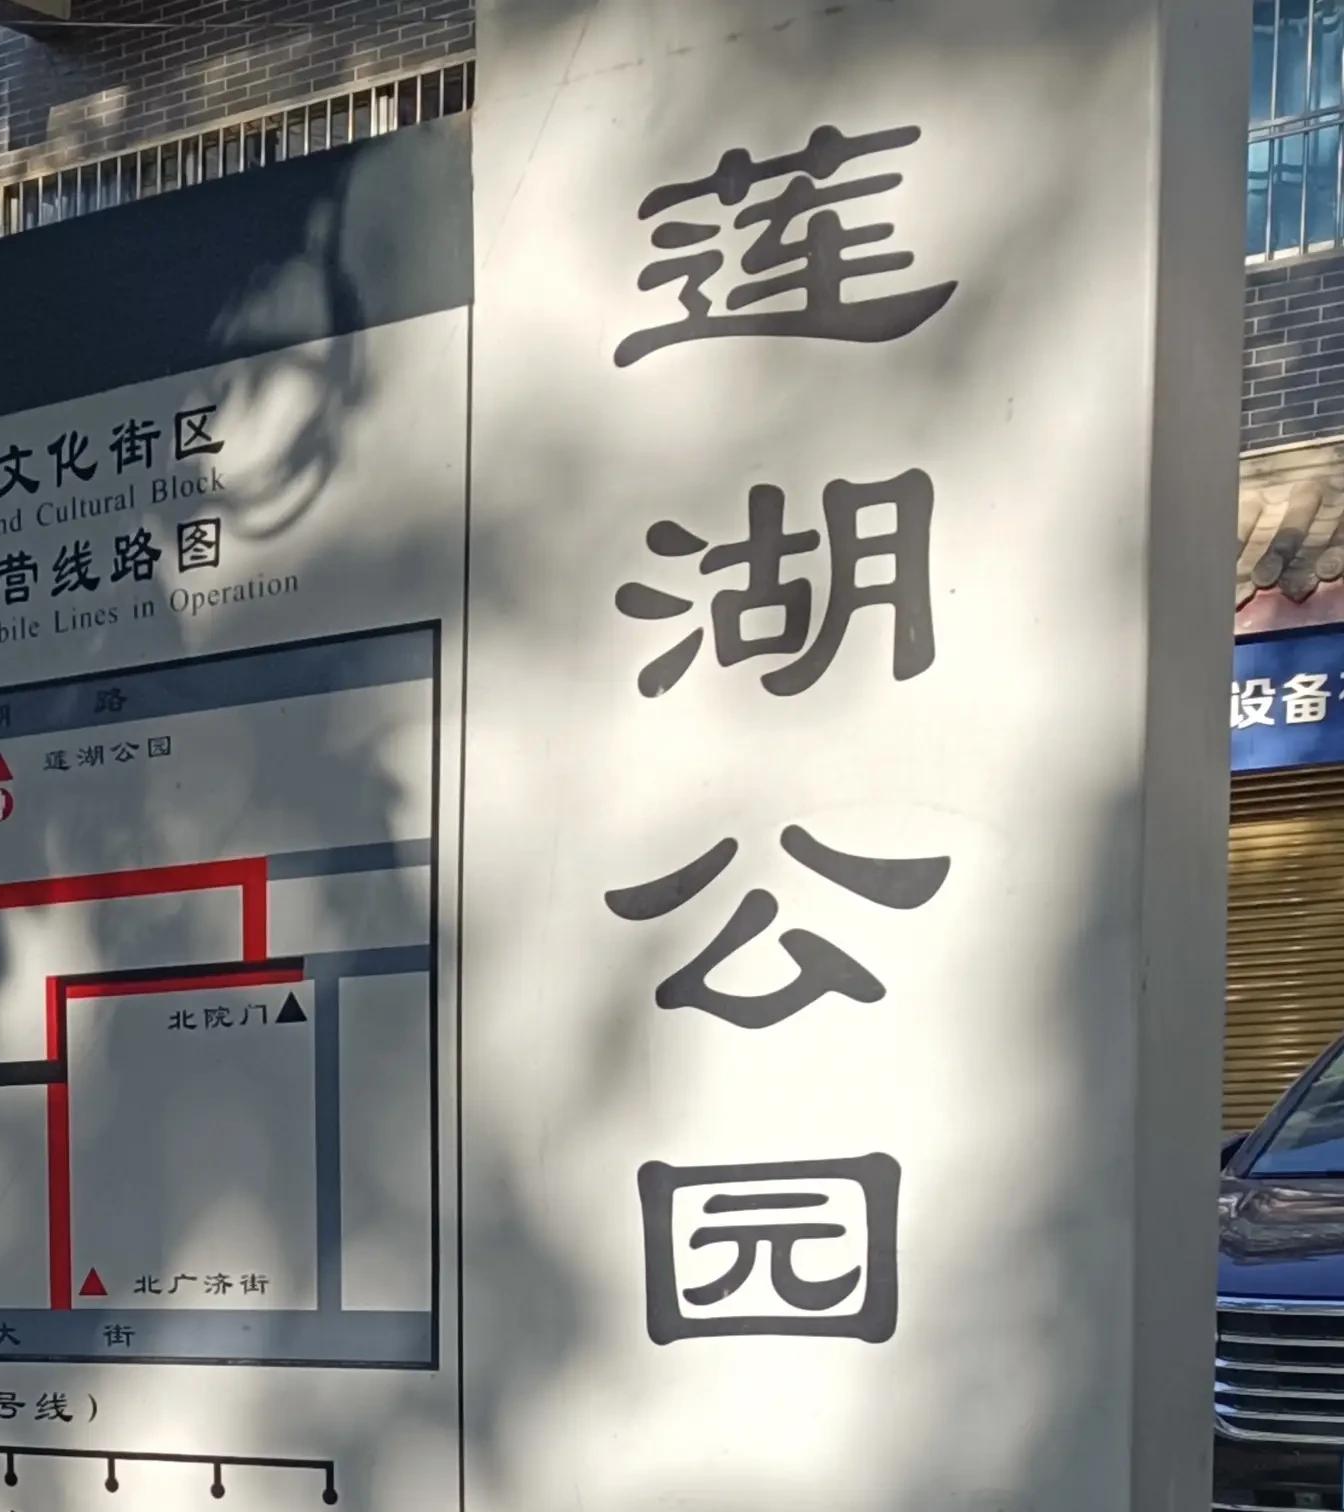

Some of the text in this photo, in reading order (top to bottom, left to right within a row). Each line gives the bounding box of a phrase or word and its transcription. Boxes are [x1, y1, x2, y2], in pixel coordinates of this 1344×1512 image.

[34, 482, 135, 527] Cultural
[150, 466, 227, 504] Block
[53, 606, 118, 634] Lines
[132, 599, 154, 620] in
[169, 574, 298, 617] Operation
[1230, 672, 1343, 729] 设备
[41, 734, 172, 772] 莲湖公园
[604, 124, 960, 1350] 莲湖公园
[166, 1003, 268, 1031] 北院门
[132, 1271, 269, 1295] 北广济街
